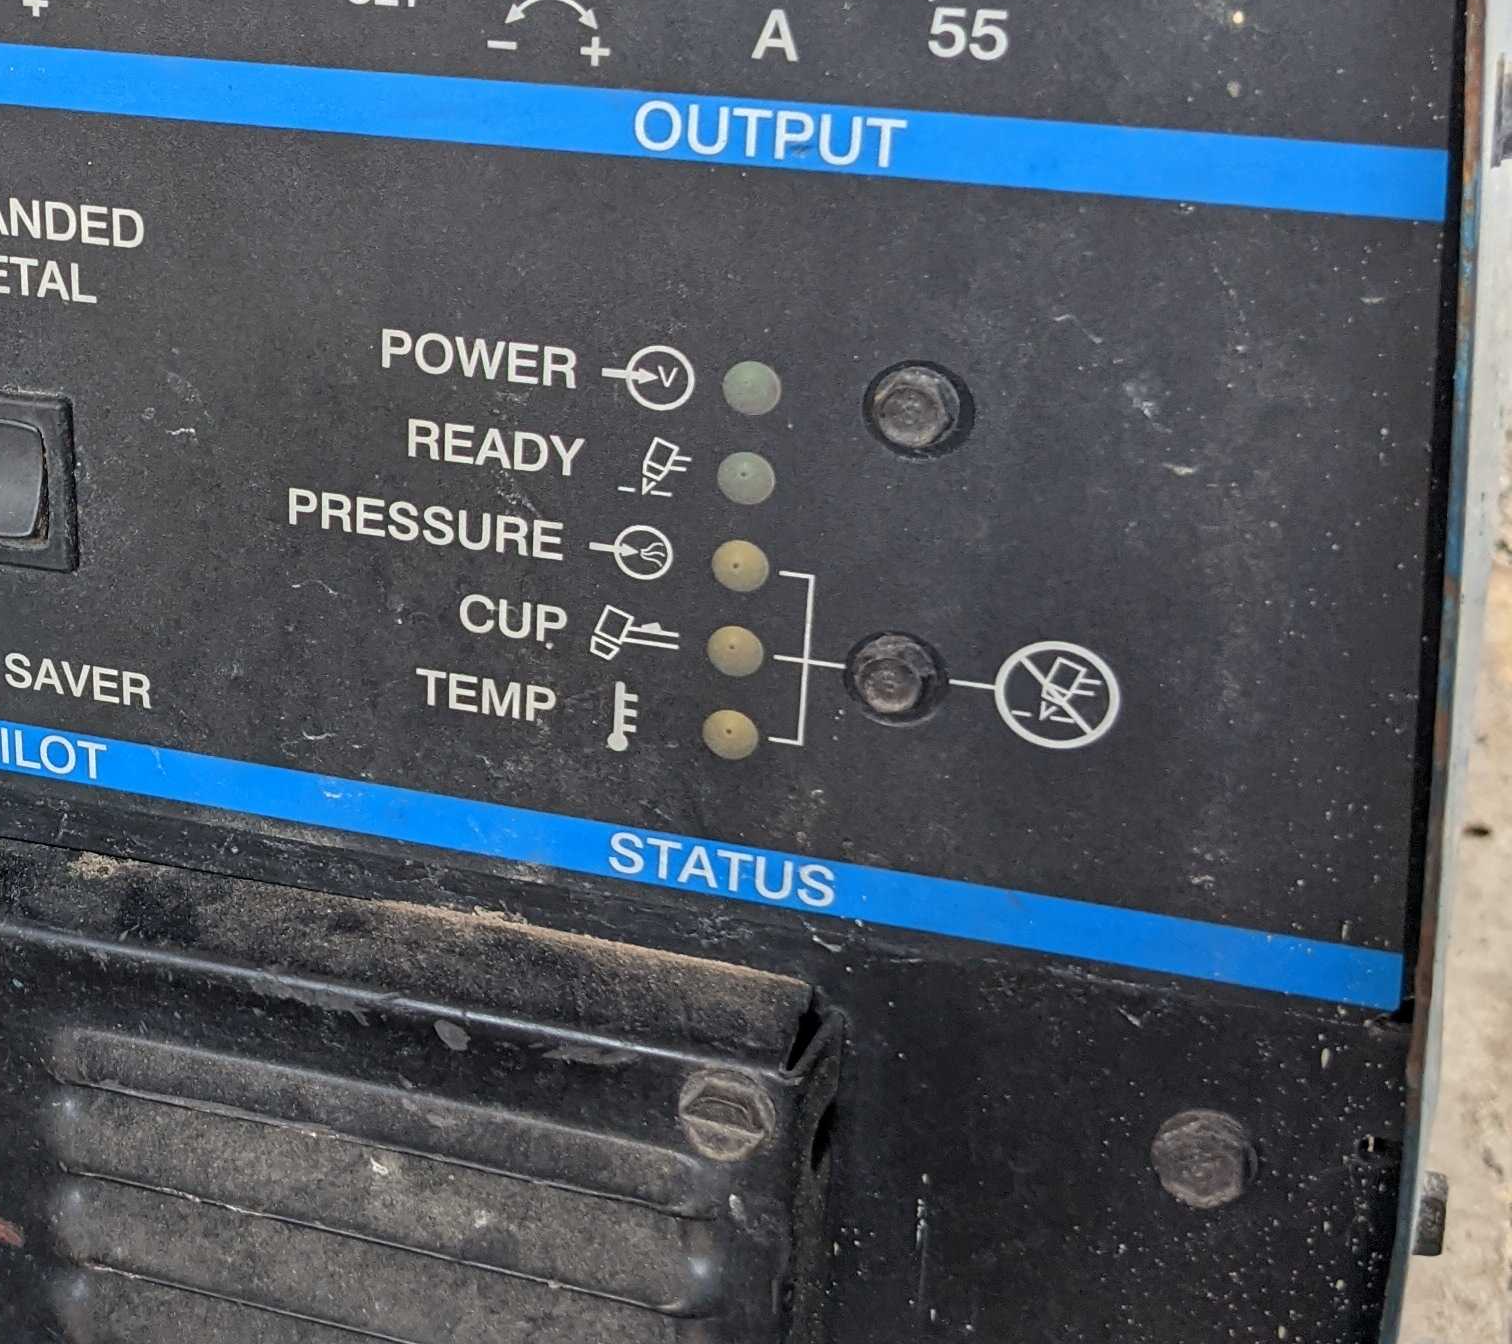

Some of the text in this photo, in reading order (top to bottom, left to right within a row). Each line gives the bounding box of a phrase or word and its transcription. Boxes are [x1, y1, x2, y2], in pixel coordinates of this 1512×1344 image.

[751, 9, 799, 62] A
[928, 6, 1009, 62] 55
[633, 100, 908, 169] OUTPUT
[380, 328, 578, 390] POWER
[407, 419, 586, 476] READY
[287, 487, 565, 562] PRESSURE
[459, 594, 568, 643] CUP
[4, 653, 153, 709] SAVER
[416, 668, 557, 723] TEMP
[608, 832, 836, 907] STATUS
